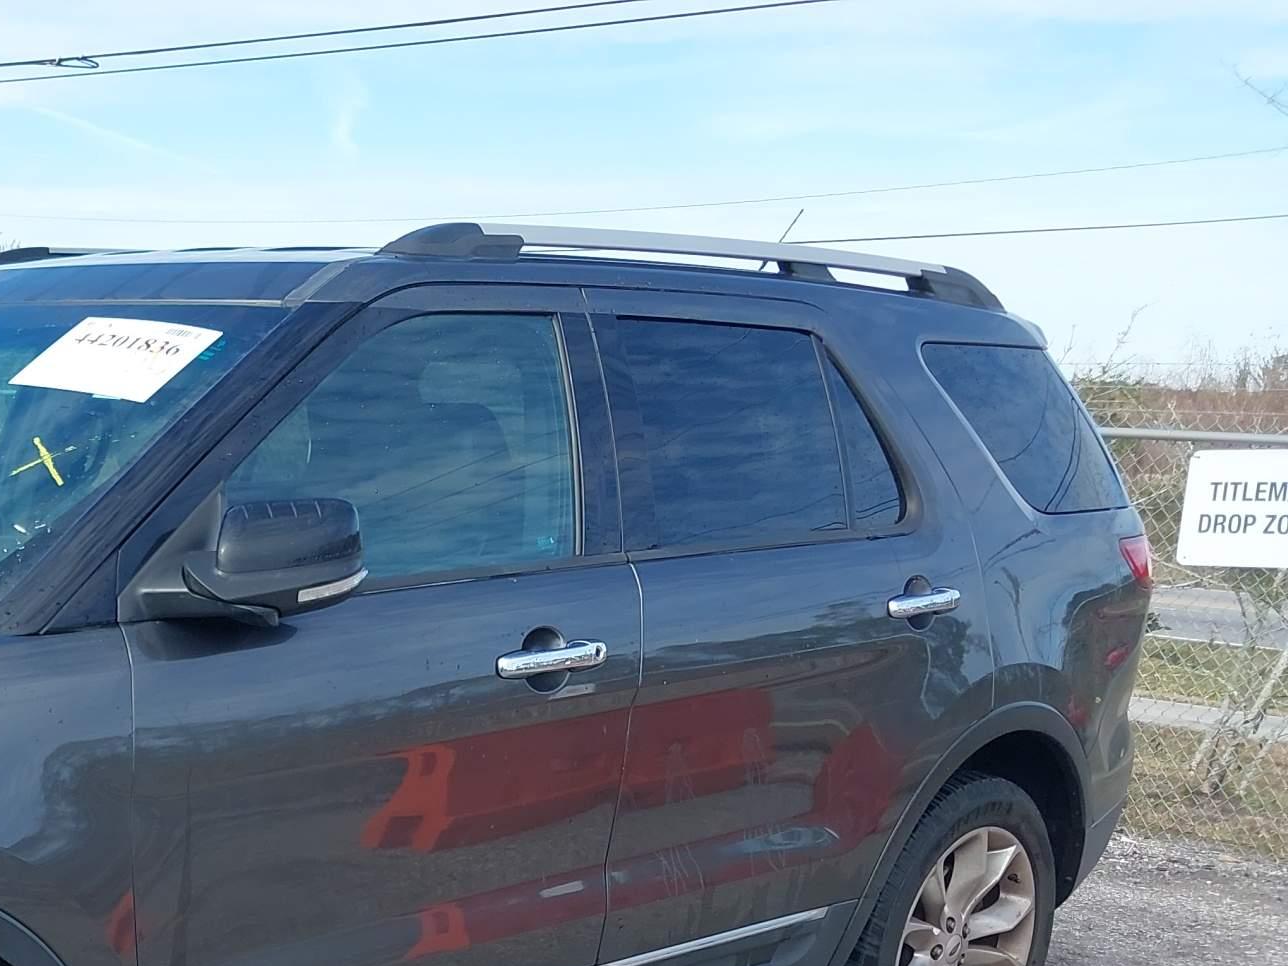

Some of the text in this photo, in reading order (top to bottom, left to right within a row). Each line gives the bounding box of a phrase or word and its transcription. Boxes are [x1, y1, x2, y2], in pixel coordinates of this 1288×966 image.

[74, 332, 181, 356] 44201836
[1210, 481, 1288, 502] TITLEM
[1198, 513, 1288, 535] DROP ZO
